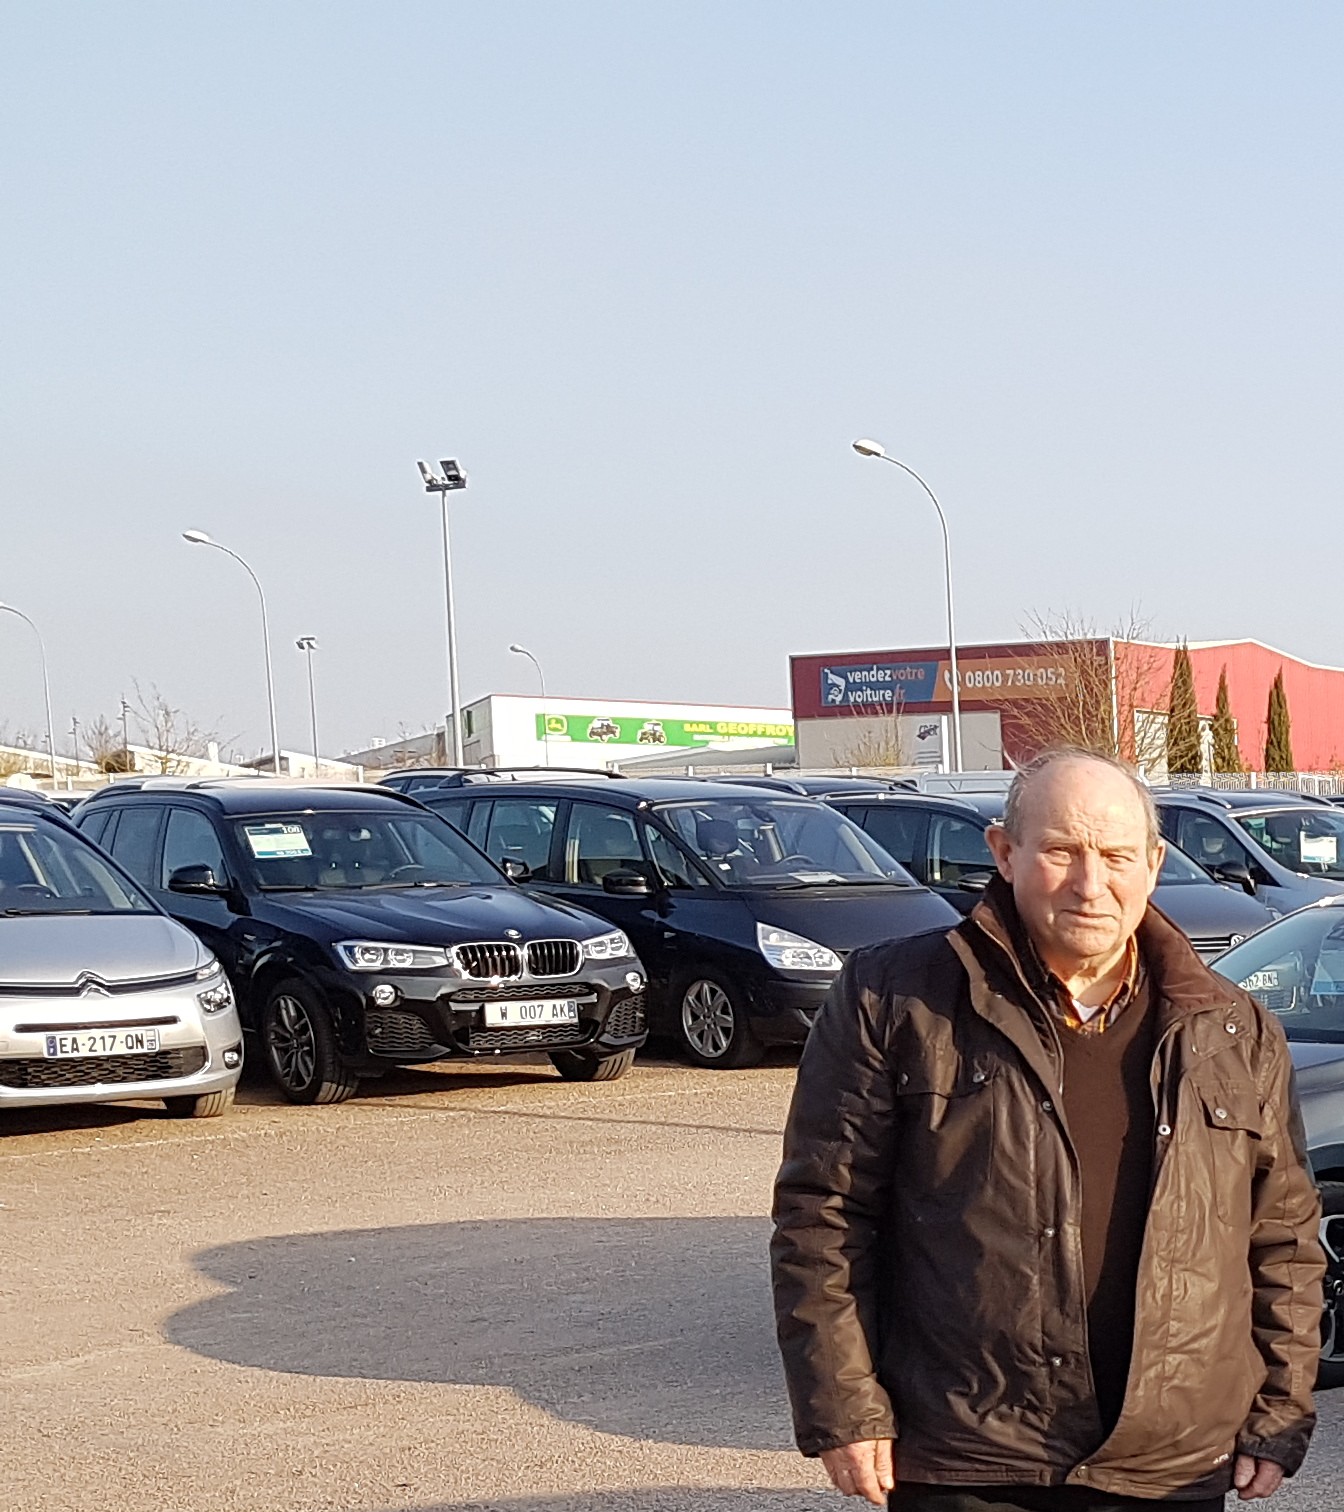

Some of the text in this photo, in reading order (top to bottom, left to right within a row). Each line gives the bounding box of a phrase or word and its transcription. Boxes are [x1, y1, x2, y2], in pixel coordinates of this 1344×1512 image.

[965, 671, 1003, 688] 0800
[1005, 669, 1034, 686] 730
[716, 722, 796, 737] GEOFFROY
